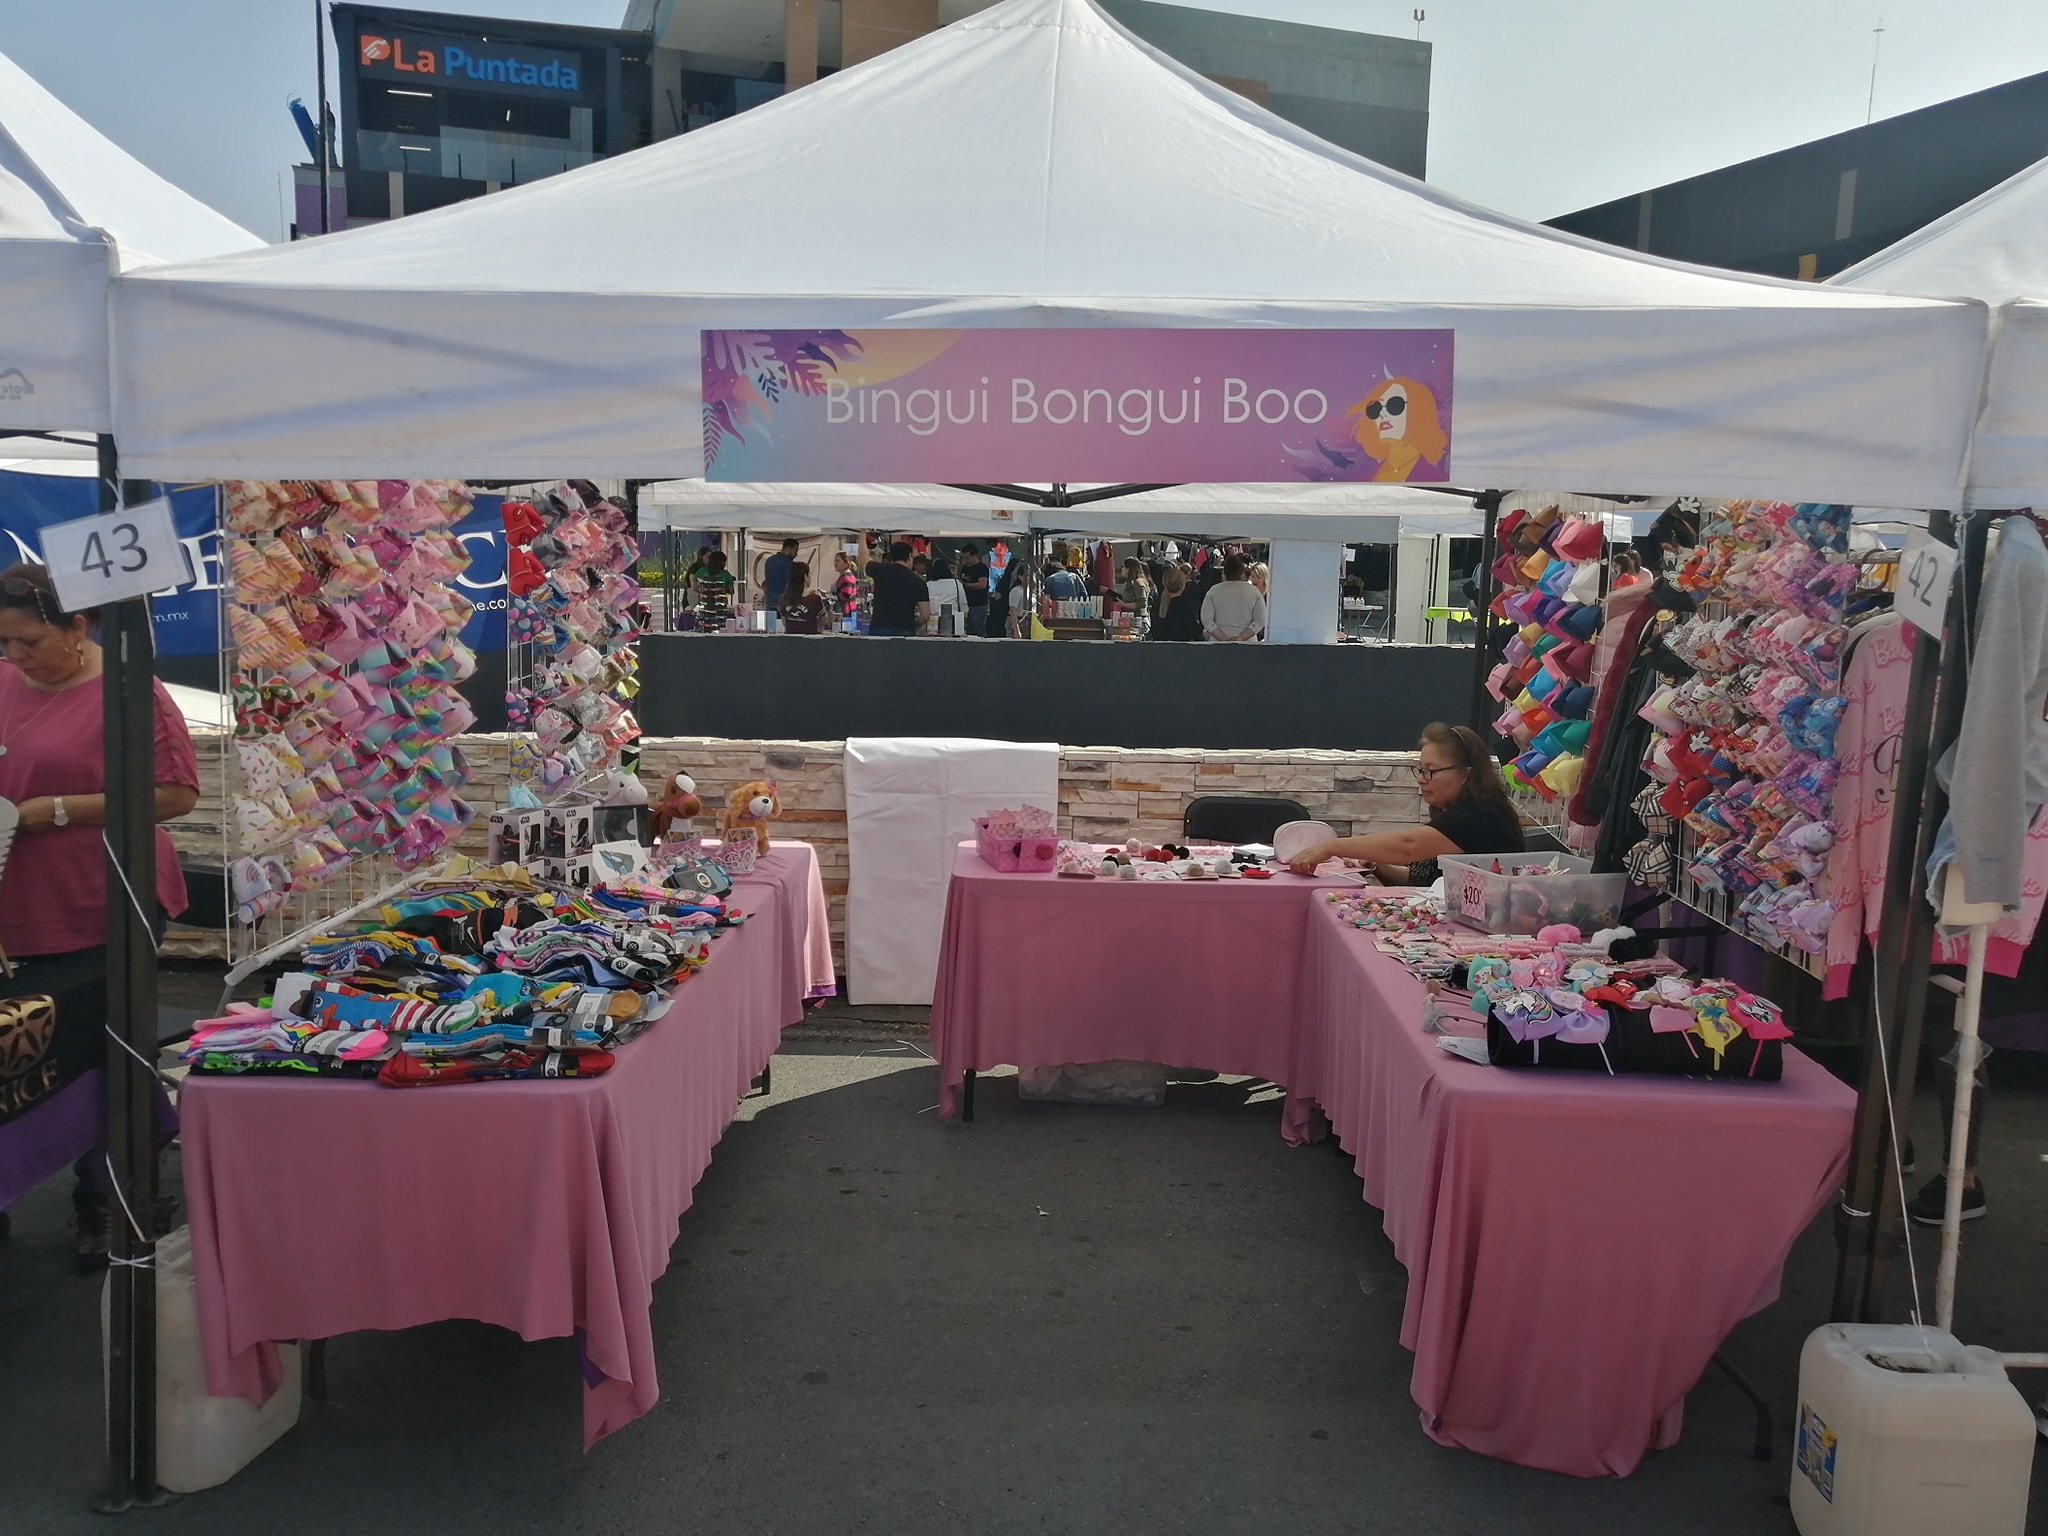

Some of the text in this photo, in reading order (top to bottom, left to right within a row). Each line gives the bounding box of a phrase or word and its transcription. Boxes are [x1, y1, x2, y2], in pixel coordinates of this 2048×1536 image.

[394, 39, 436, 73] La
[443, 46, 579, 91] Puntada
[826, 376, 1328, 436] Bingui Bongui Boo
[81, 523, 148, 578] 43
[1908, 550, 1938, 607] 42
